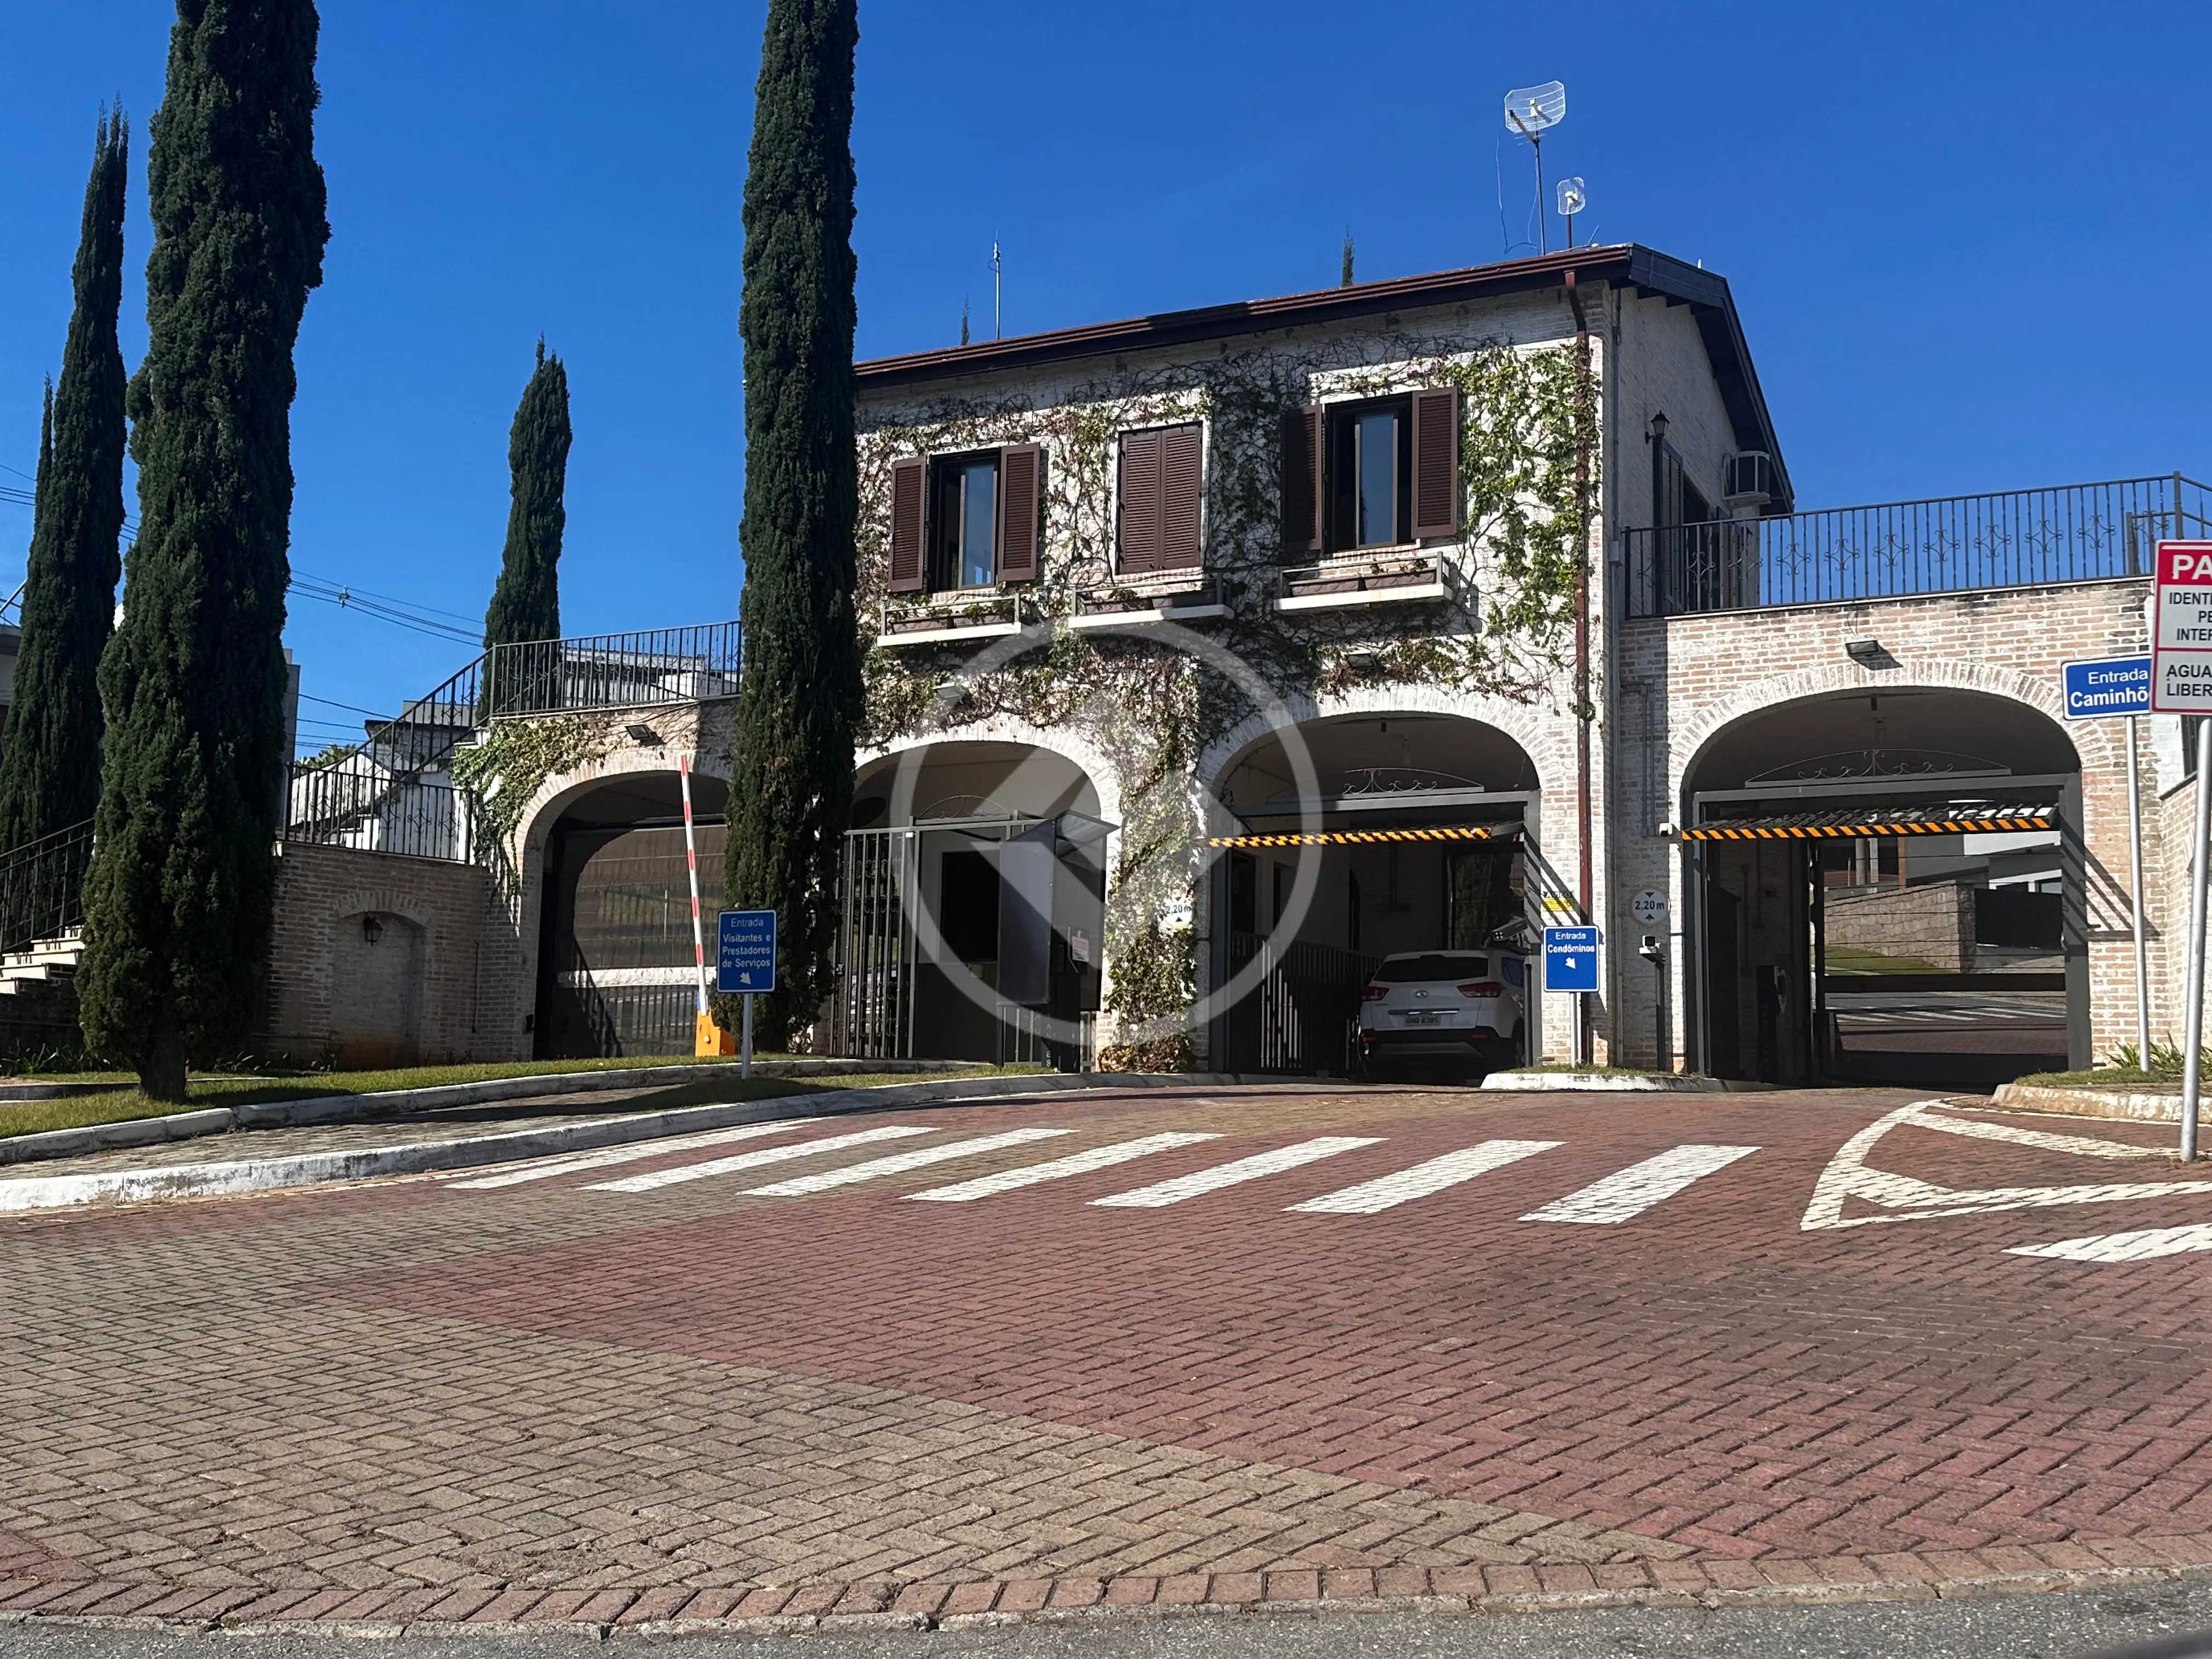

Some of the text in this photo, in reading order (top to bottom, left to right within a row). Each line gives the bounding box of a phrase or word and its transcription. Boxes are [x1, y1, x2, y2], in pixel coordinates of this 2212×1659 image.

[2172, 555, 2212, 580] PA
[2166, 664, 2212, 678] AGUA
[2088, 669, 2148, 685] Entrada
[2167, 683, 2212, 696] LIBER
[2070, 686, 2149, 708] Caminhõ
[1164, 904, 1183, 915] 2,20
[1635, 900, 1664, 912] 2,20 m
[731, 918, 764, 927] Entrada
[723, 934, 763, 943] Visitantes
[1555, 932, 1587, 940] Entrada
[722, 946, 771, 955] Prestadores
[1547, 944, 1595, 953] Condôminos
[722, 958, 770, 969] de Serviços
